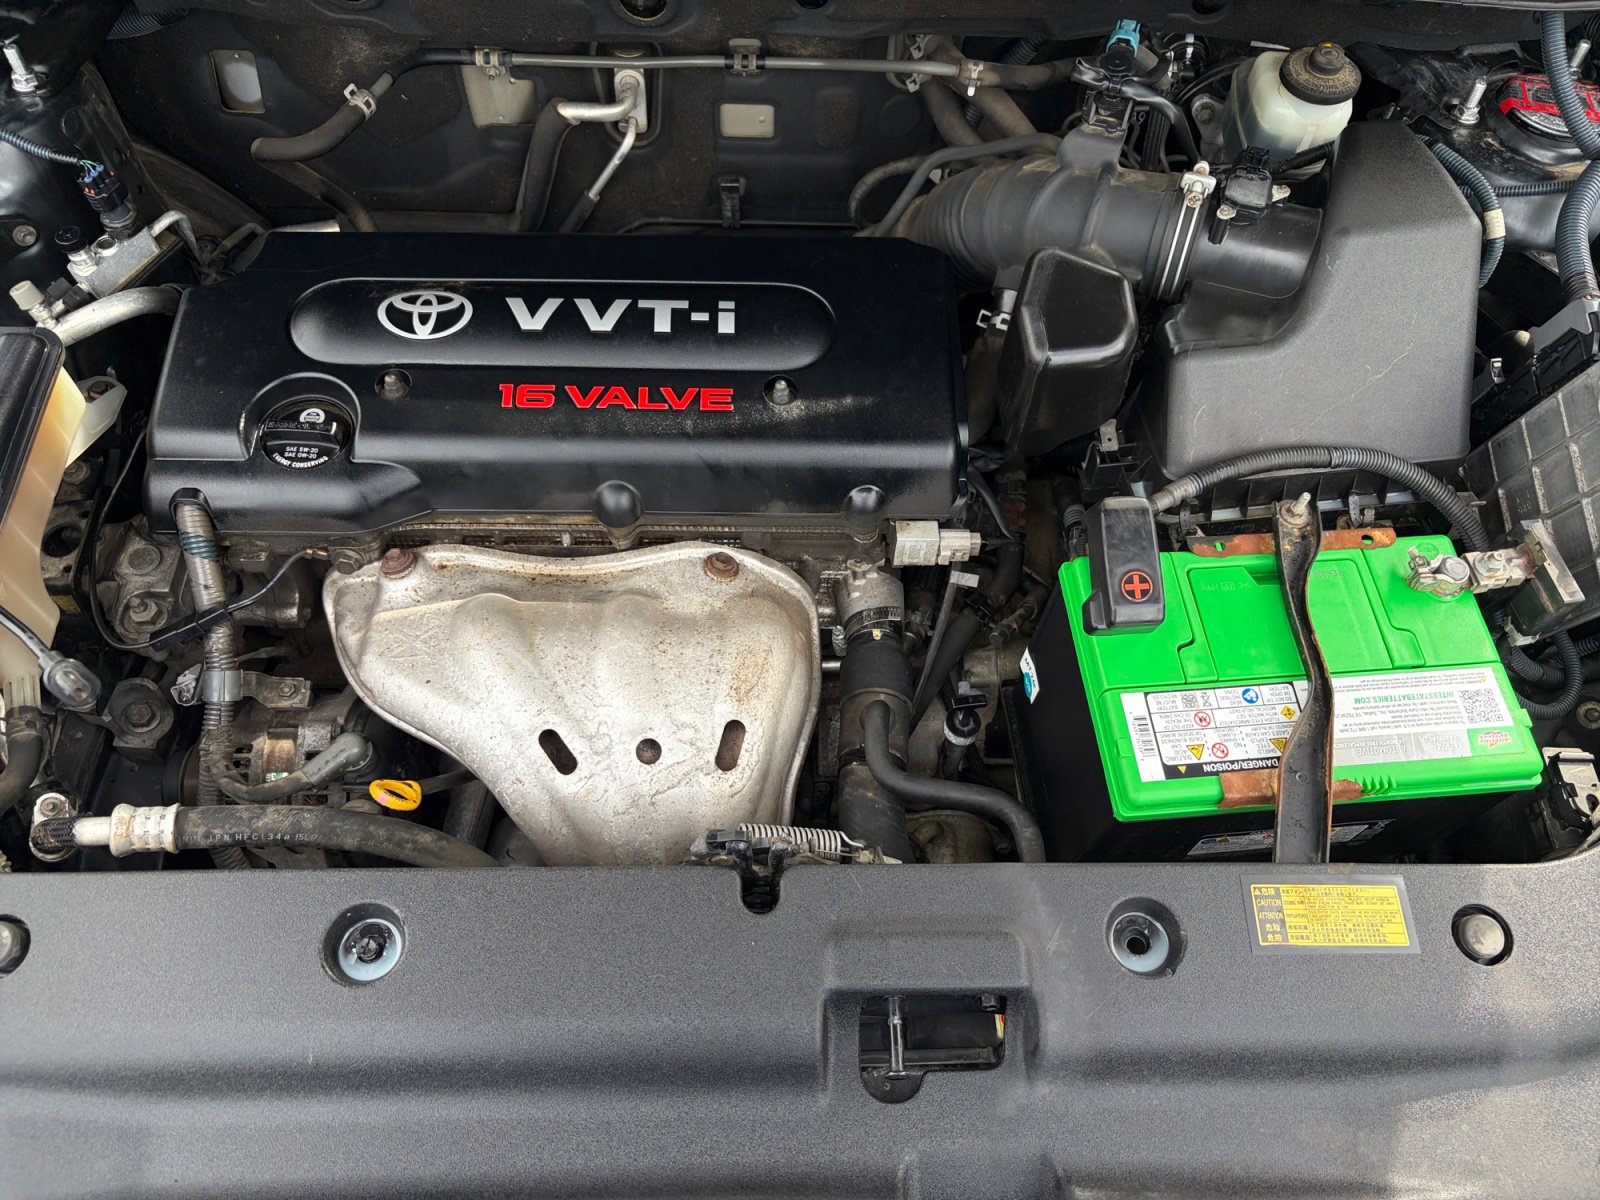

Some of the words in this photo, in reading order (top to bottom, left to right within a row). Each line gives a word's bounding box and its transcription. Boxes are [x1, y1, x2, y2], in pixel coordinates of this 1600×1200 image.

[505, 297, 735, 333] VVT-i
[499, 384, 555, 408] 16
[564, 385, 734, 411] VALVE
[272, 452, 291, 466] ENERGY
[291, 455, 328, 468] CONSERVING
[1353, 690, 1454, 704] INTERSTATEBATTERIES.COM
[1357, 744, 1407, 755] AUTOMOTIVE
[1202, 758, 1278, 771] DANGER/POISON
[1256, 898, 1281, 906] CAUTION
[1258, 911, 1283, 919] ATTENTION
